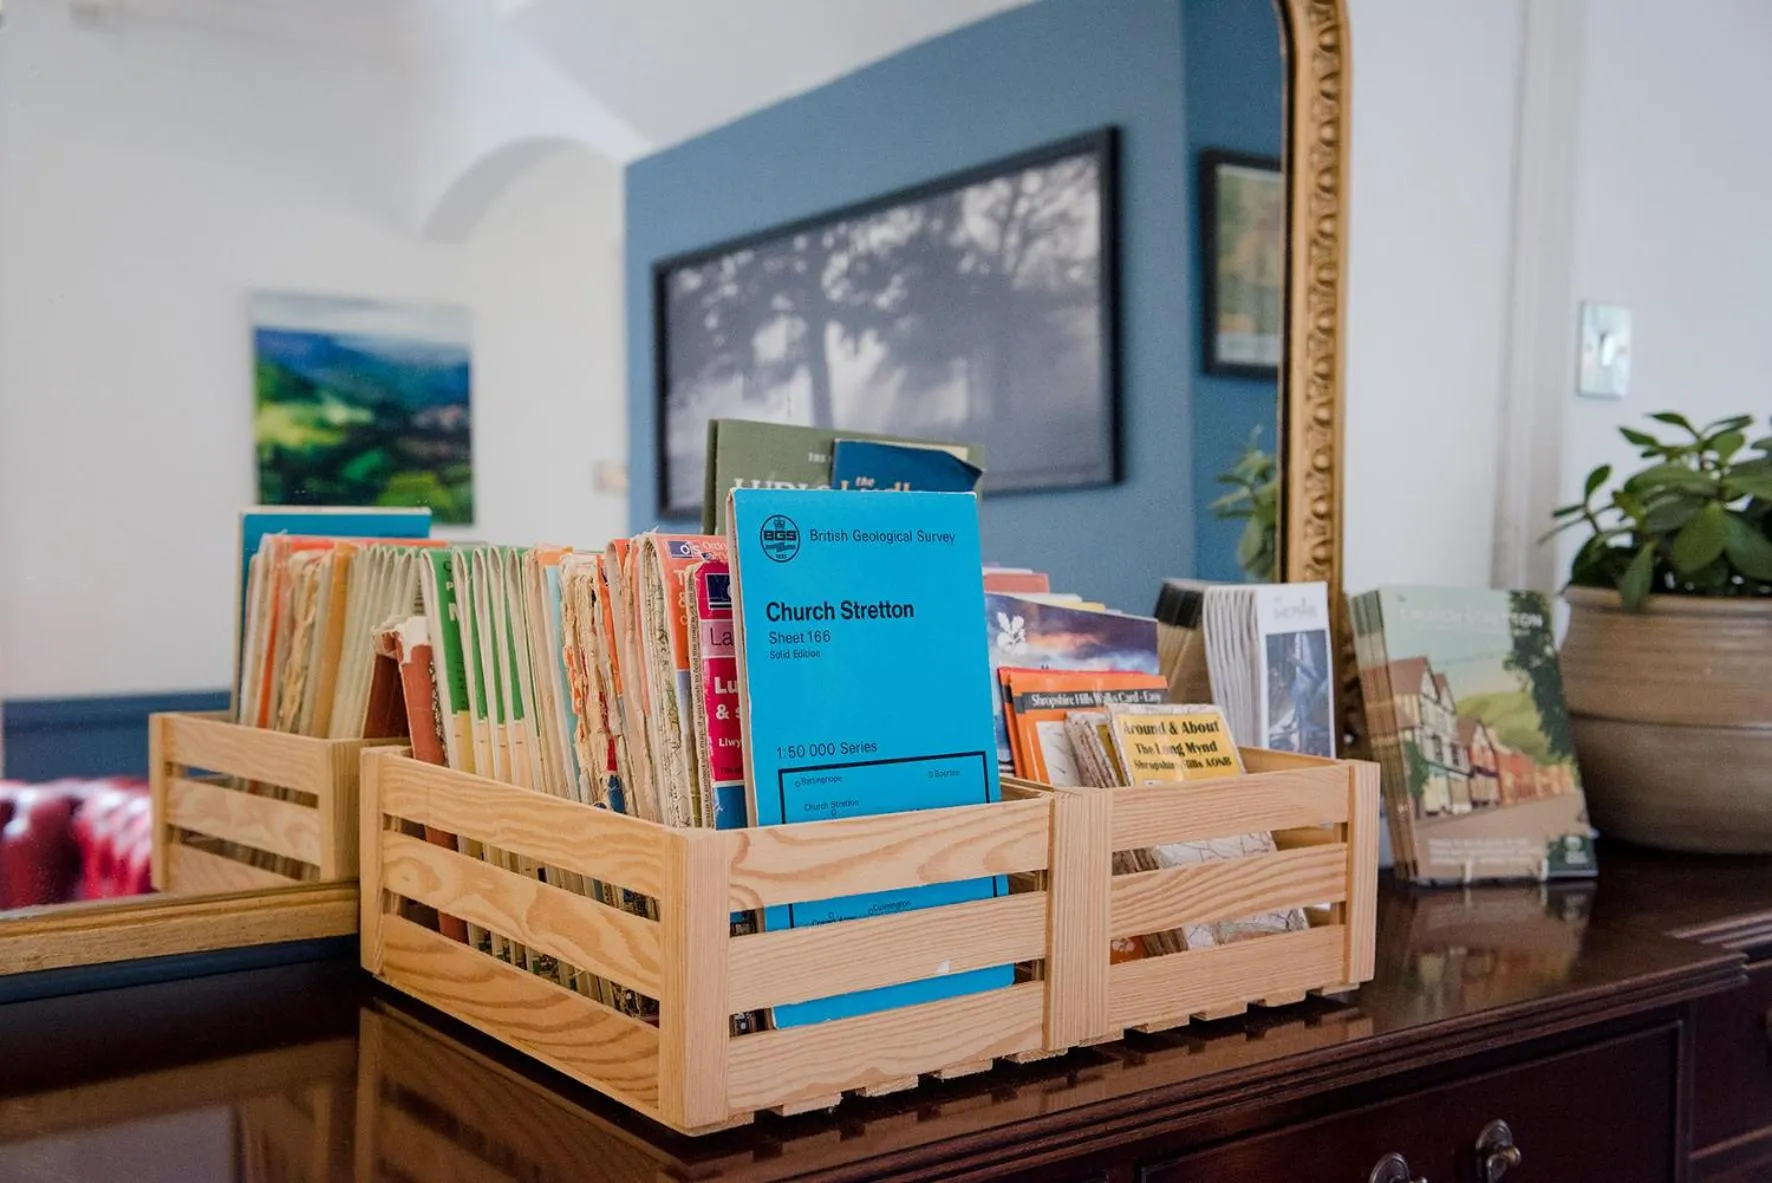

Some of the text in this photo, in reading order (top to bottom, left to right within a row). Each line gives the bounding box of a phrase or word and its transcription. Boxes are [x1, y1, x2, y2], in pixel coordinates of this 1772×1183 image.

[764, 530, 797, 541] BGS
[809, 529, 955, 545] British Geological Survey
[766, 599, 914, 622] Church Stretton
[769, 630, 832, 645] Sheet 166
[769, 649, 820, 660] Solid Edition
[1181, 720, 1220, 734] About
[776, 740, 877, 760] 1:50 000 Series
[1185, 740, 1218, 755] Mynd
